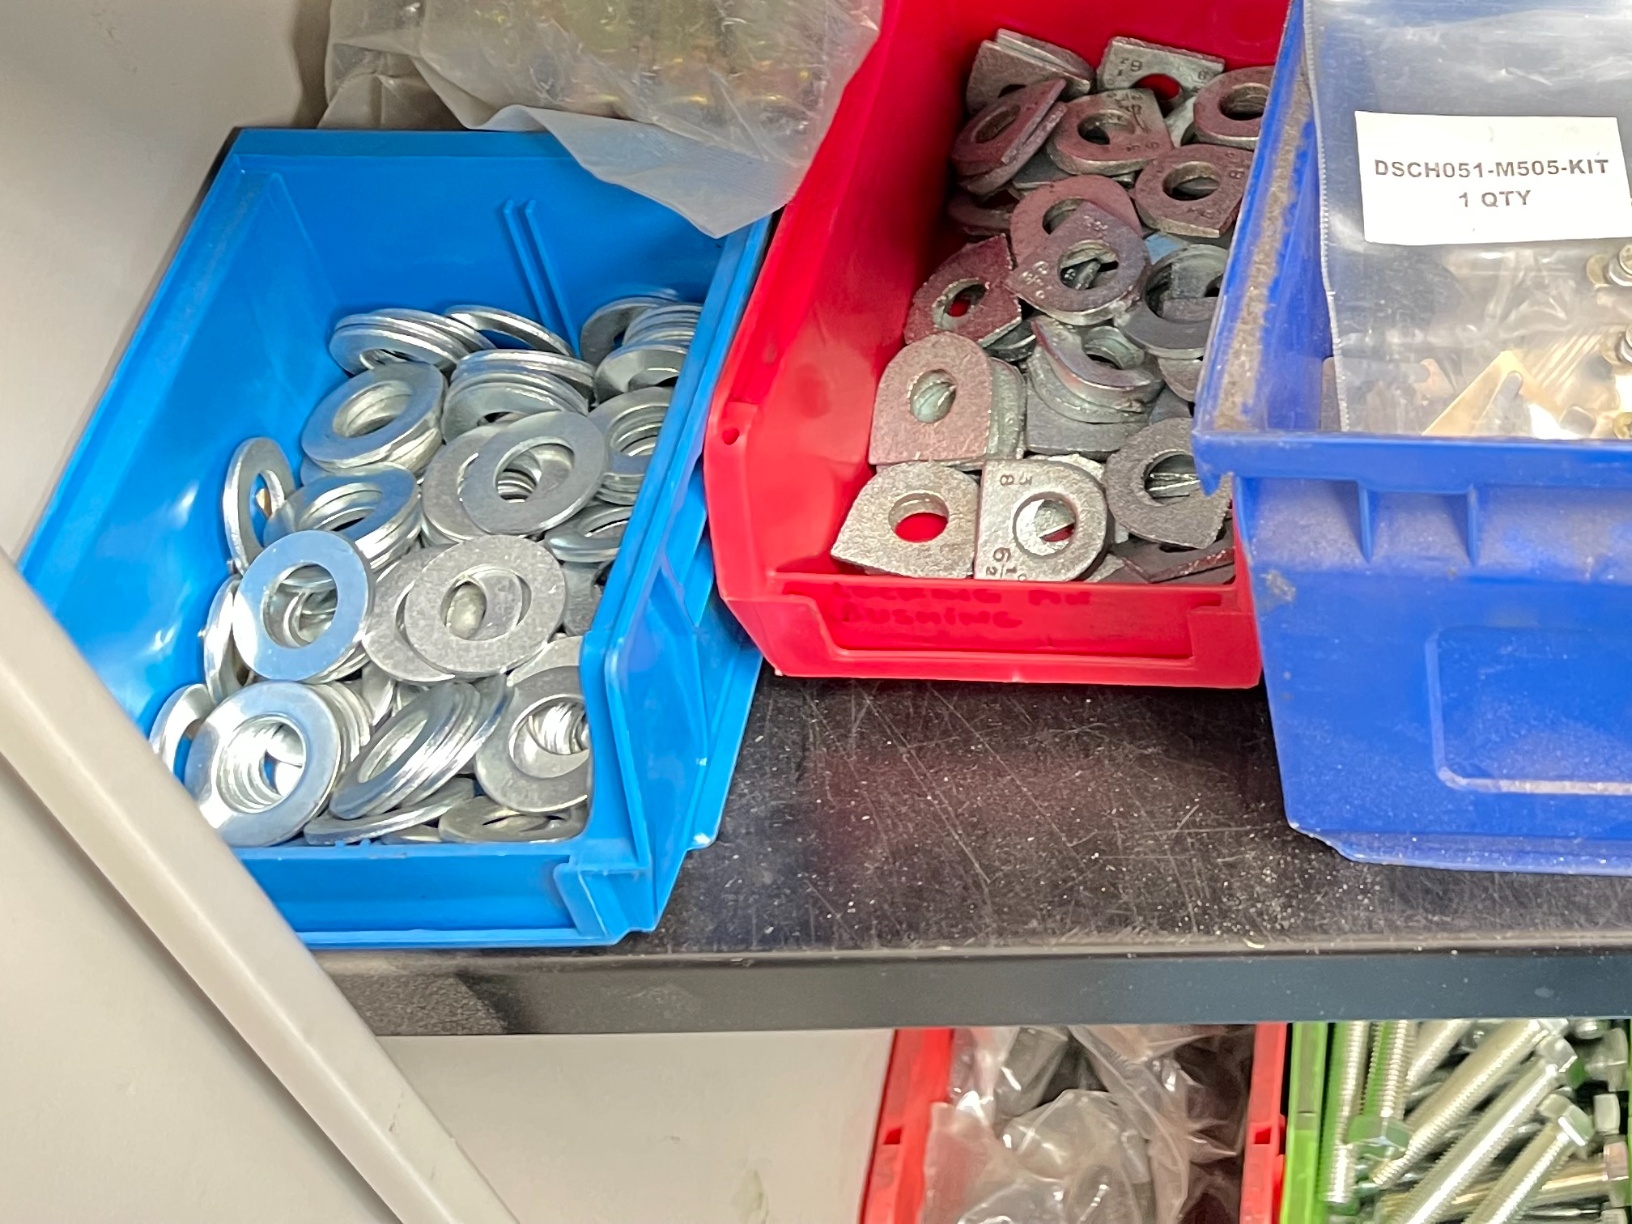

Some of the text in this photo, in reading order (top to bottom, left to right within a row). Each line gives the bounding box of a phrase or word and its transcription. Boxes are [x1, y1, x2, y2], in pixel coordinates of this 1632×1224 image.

[1374, 159, 1610, 178] DSCH051-M505-KIT
[1459, 190, 1532, 208] 1 QTY
